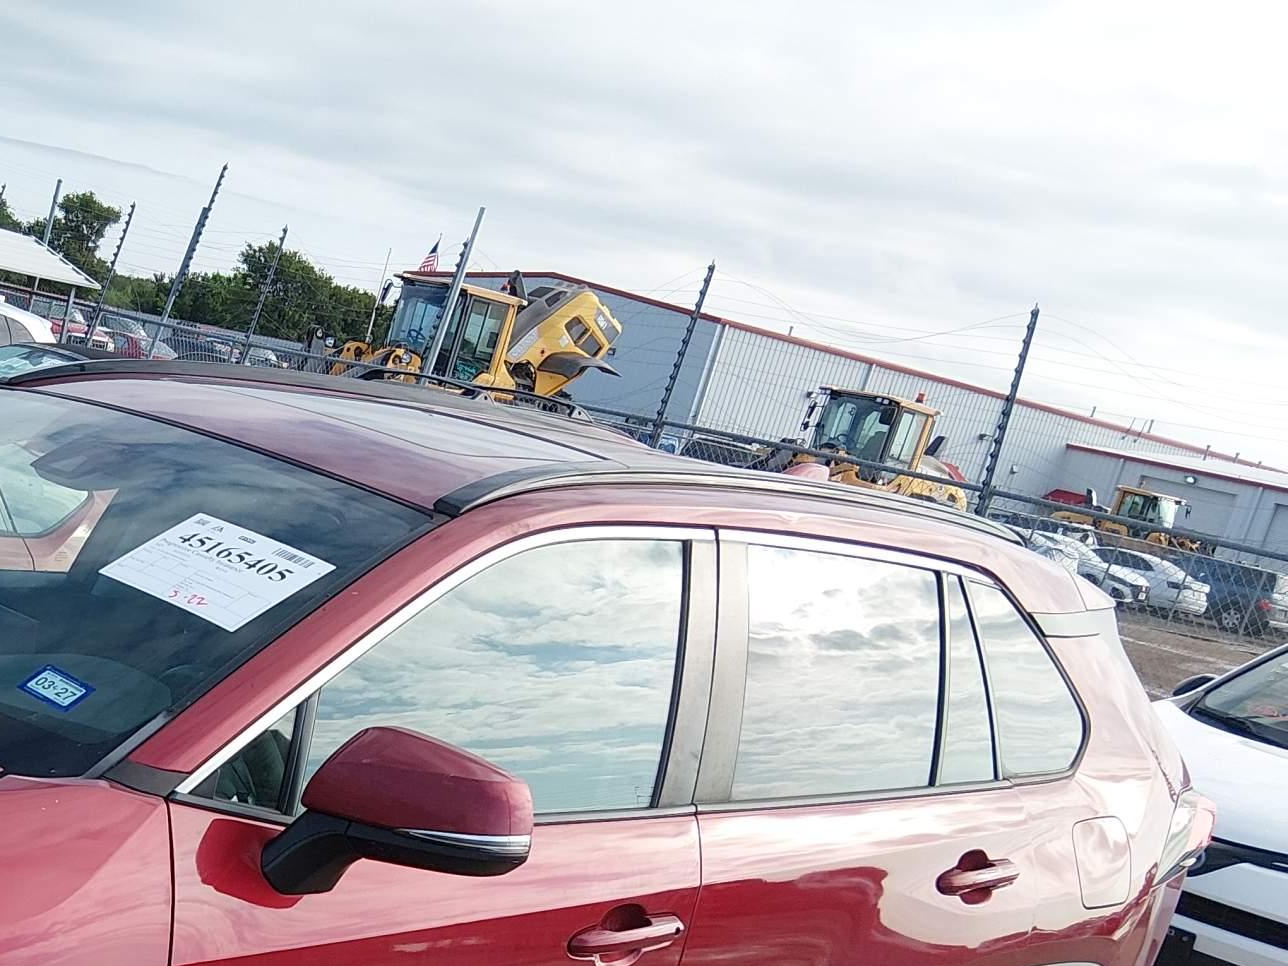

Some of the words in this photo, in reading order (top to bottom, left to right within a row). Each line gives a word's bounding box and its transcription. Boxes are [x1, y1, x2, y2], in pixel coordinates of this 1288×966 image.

[178, 532, 295, 582] 45165405
[35, 677, 55, 690] 03
[54, 687, 77, 700] 27
